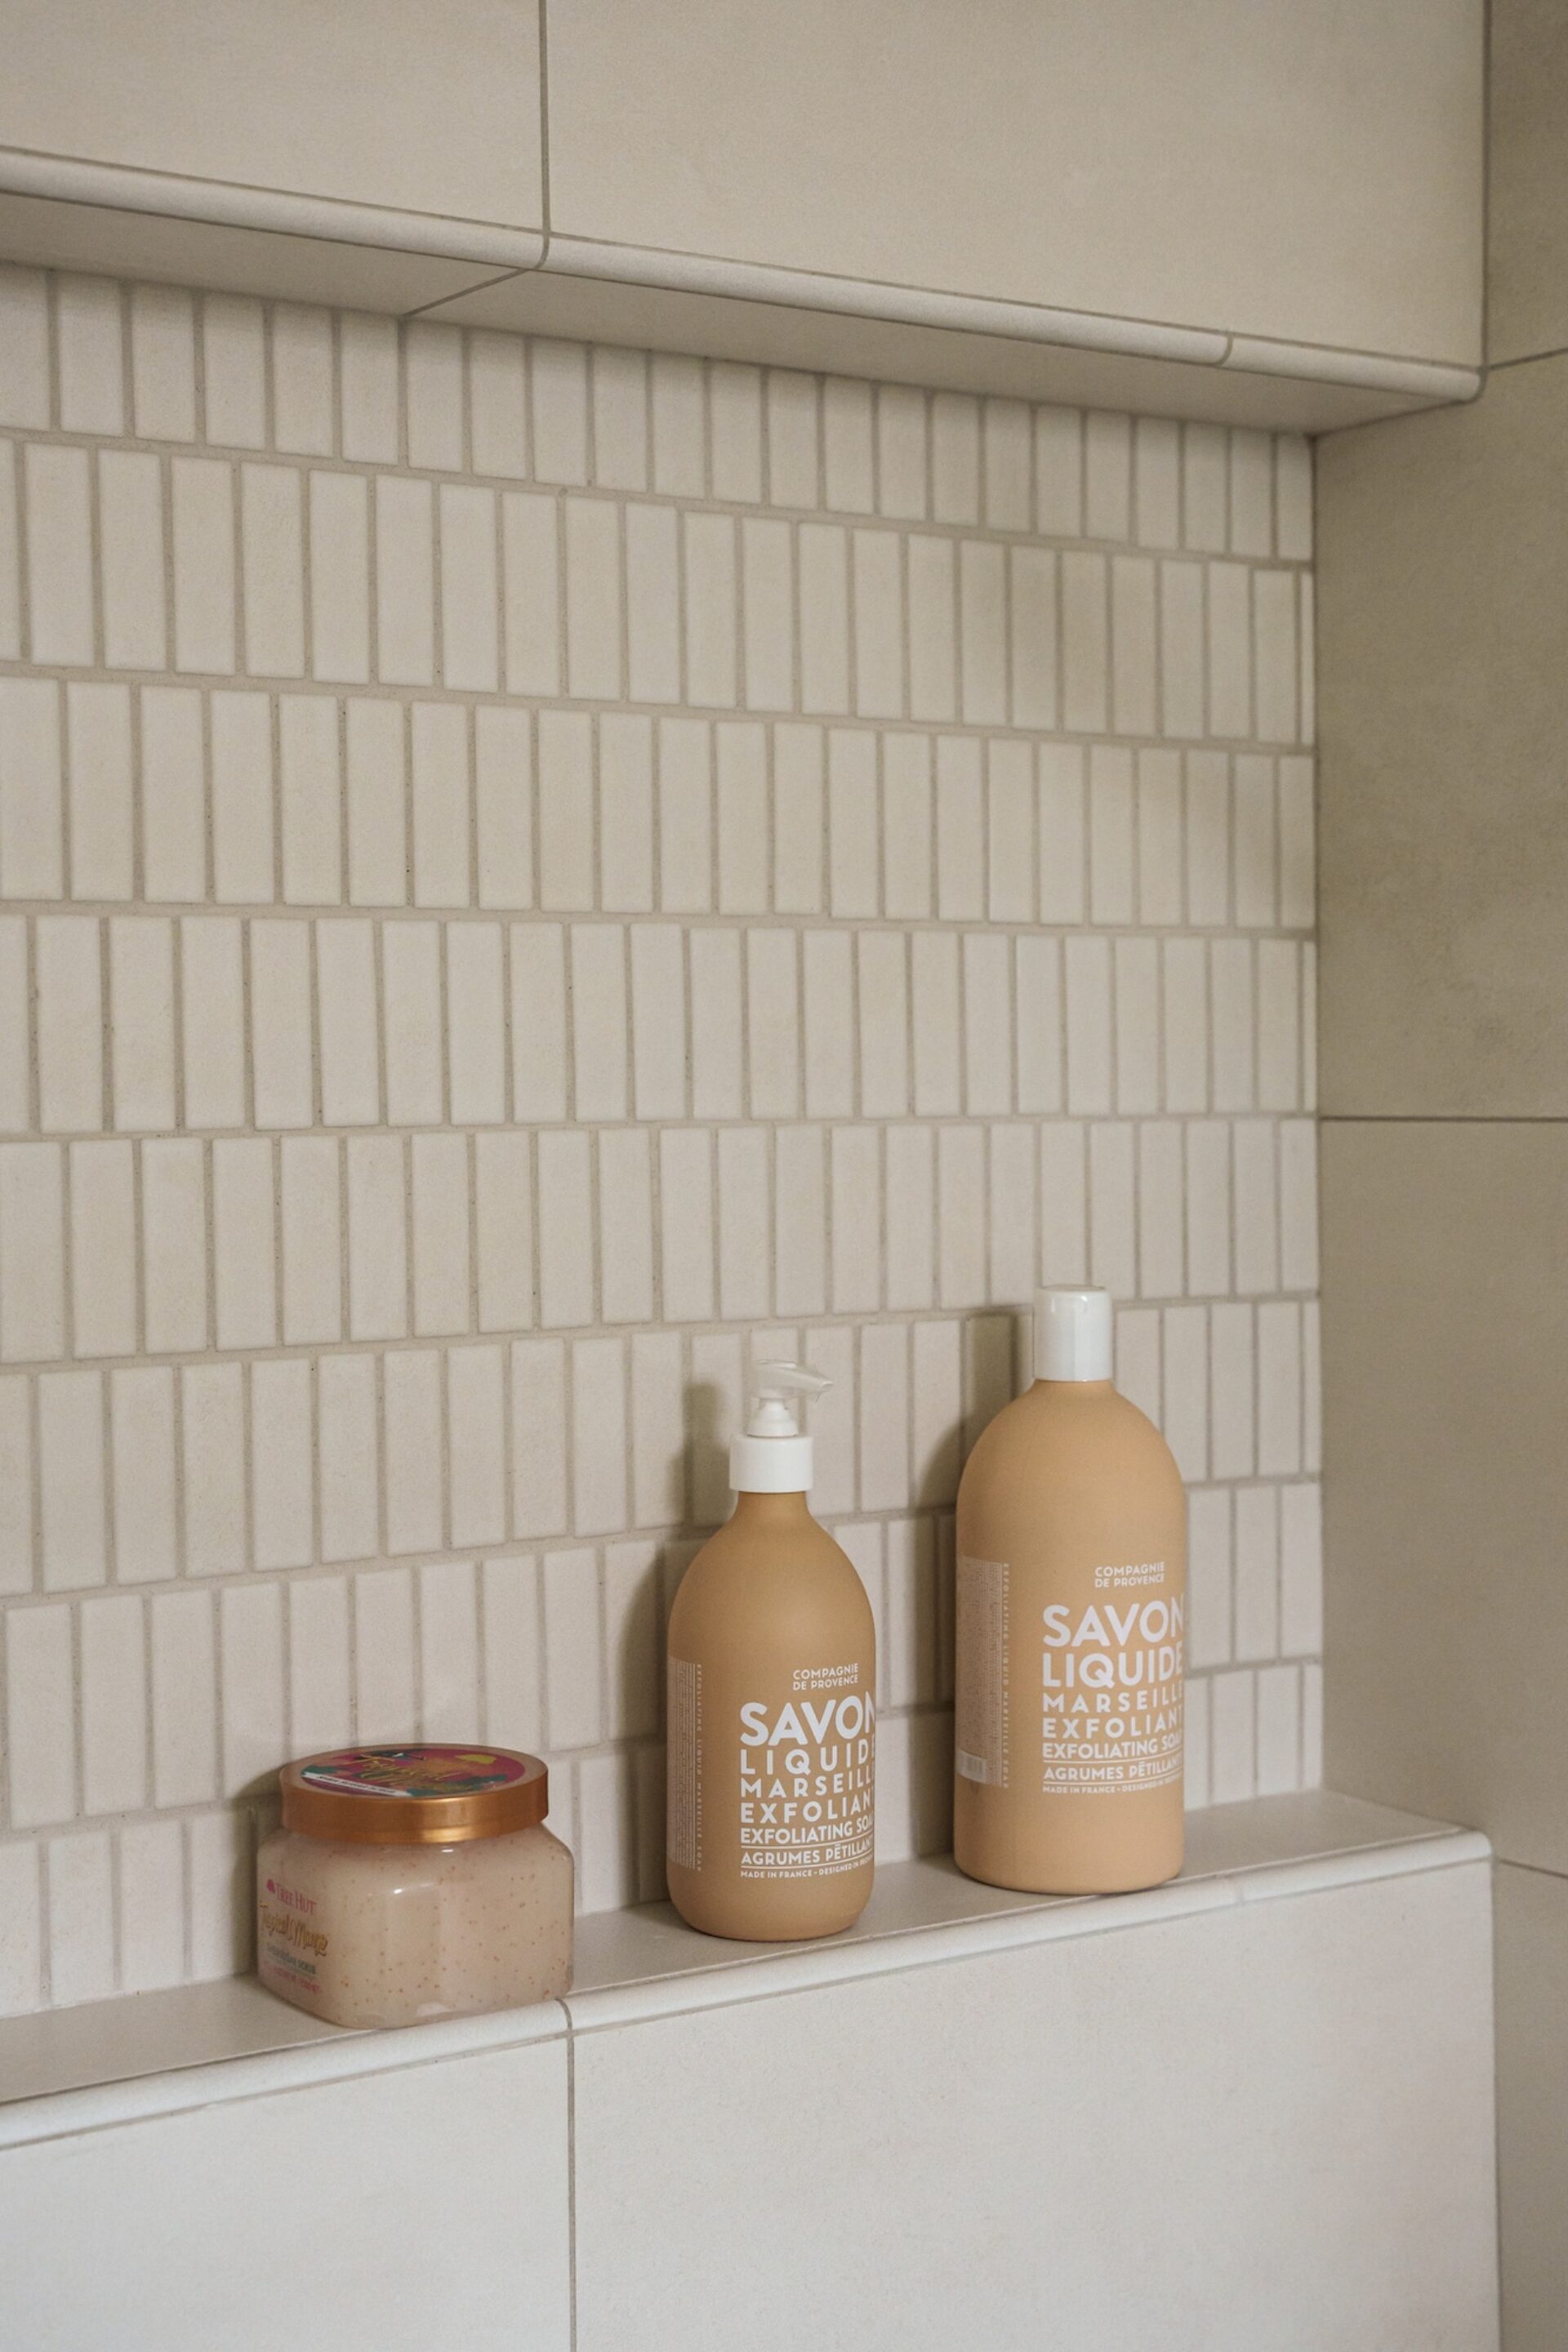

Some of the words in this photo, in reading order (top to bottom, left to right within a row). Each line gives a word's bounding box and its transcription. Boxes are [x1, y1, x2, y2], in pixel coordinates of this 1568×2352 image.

[1094, 1561, 1165, 1577] COMPAGNIE
[1094, 1578, 1109, 1588] DE
[1114, 1572, 1165, 1587] PROVENCE
[1042, 1595, 1183, 1647] SAVON
[792, 1663, 858, 1681] COMPAGNIE
[792, 1681, 807, 1691] DE
[810, 1673, 858, 1690] PROVENCE
[741, 1735, 875, 1775] LIQUID
[1042, 1739, 1158, 1759] EXFOLIATING
[741, 1760, 874, 1798] MARSEILL
[1043, 1766, 1123, 1781] AGRUMES
[1042, 1785, 1067, 1794] MADE
[1070, 1786, 1080, 1794] IN
[1082, 1785, 1116, 1794] FRANCE
[741, 1786, 874, 1824] EXFOLIAN
[740, 1821, 853, 1844] EXFOLIATING
[741, 1851, 820, 1866] AGRUMES
[740, 1869, 765, 1878] MADE
[768, 1870, 777, 1878] IN
[779, 1869, 813, 1878] FRANCE
